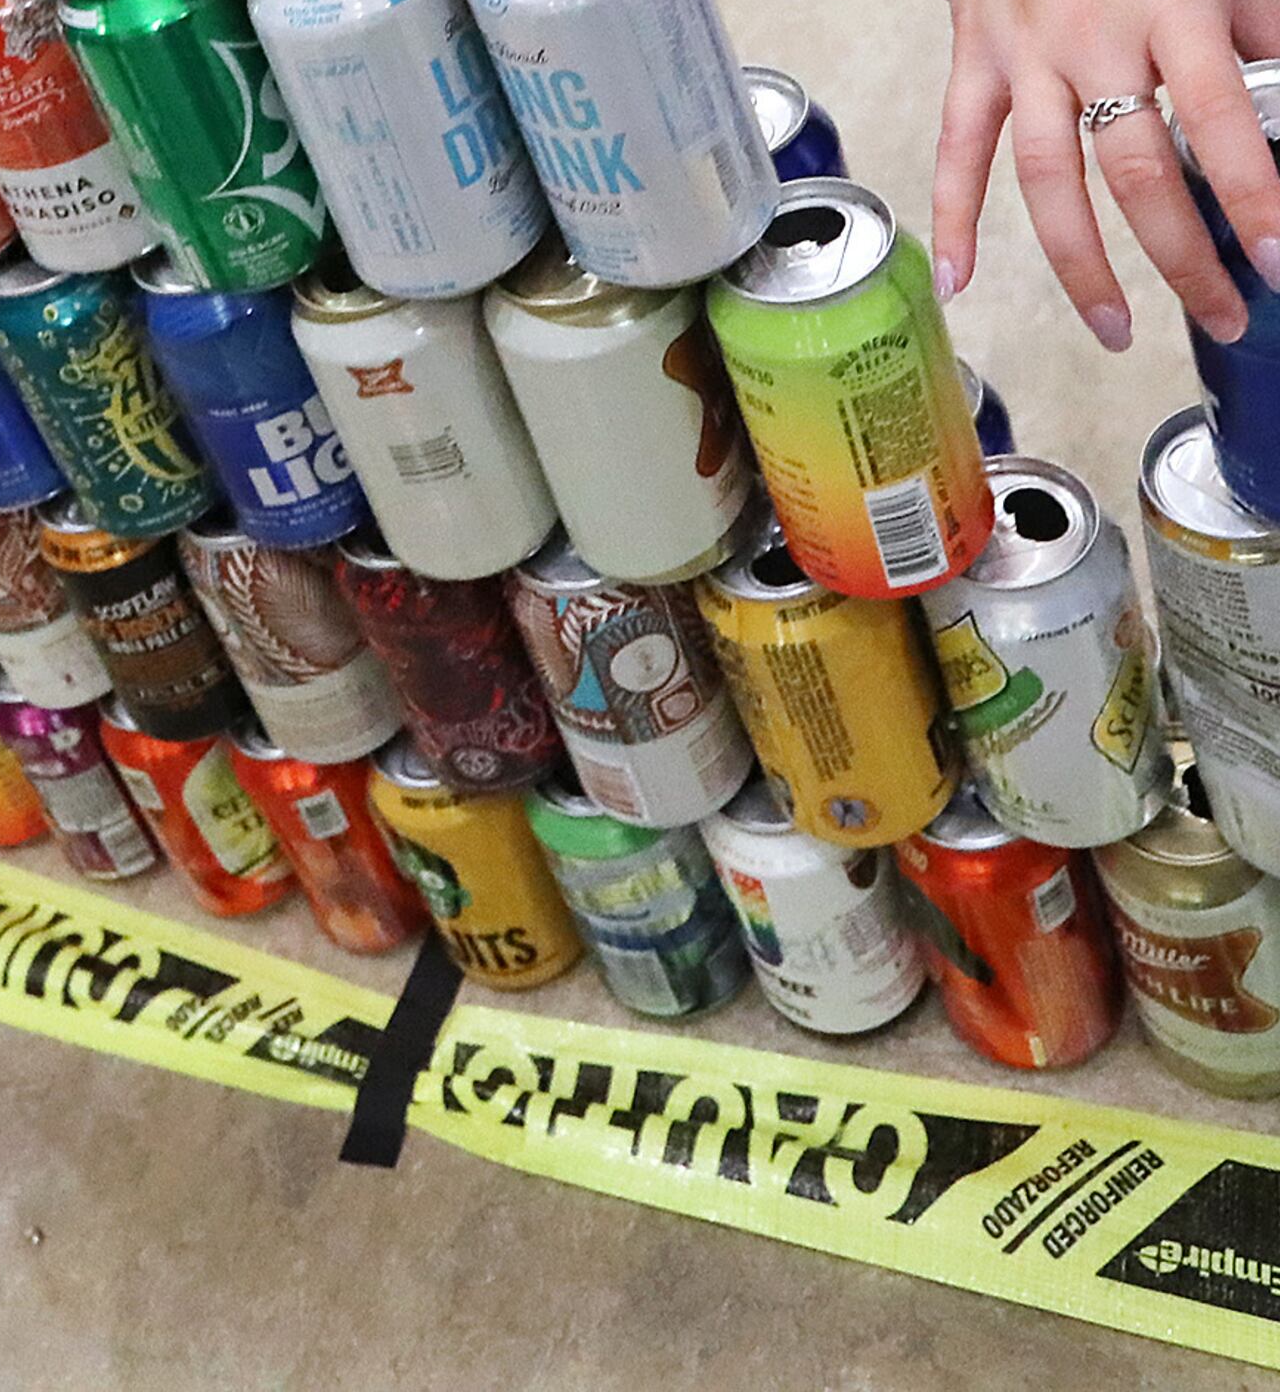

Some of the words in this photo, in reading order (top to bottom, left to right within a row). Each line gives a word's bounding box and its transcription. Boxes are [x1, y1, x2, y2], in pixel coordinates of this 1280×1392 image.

[13, 189, 116, 221] ARADISO
[248, 434, 355, 507] LIG
[1169, 986, 1239, 1015] LIFE
[980, 1137, 1098, 1241] REFORZADO
[1041, 1145, 1166, 1260] REINFORCED
